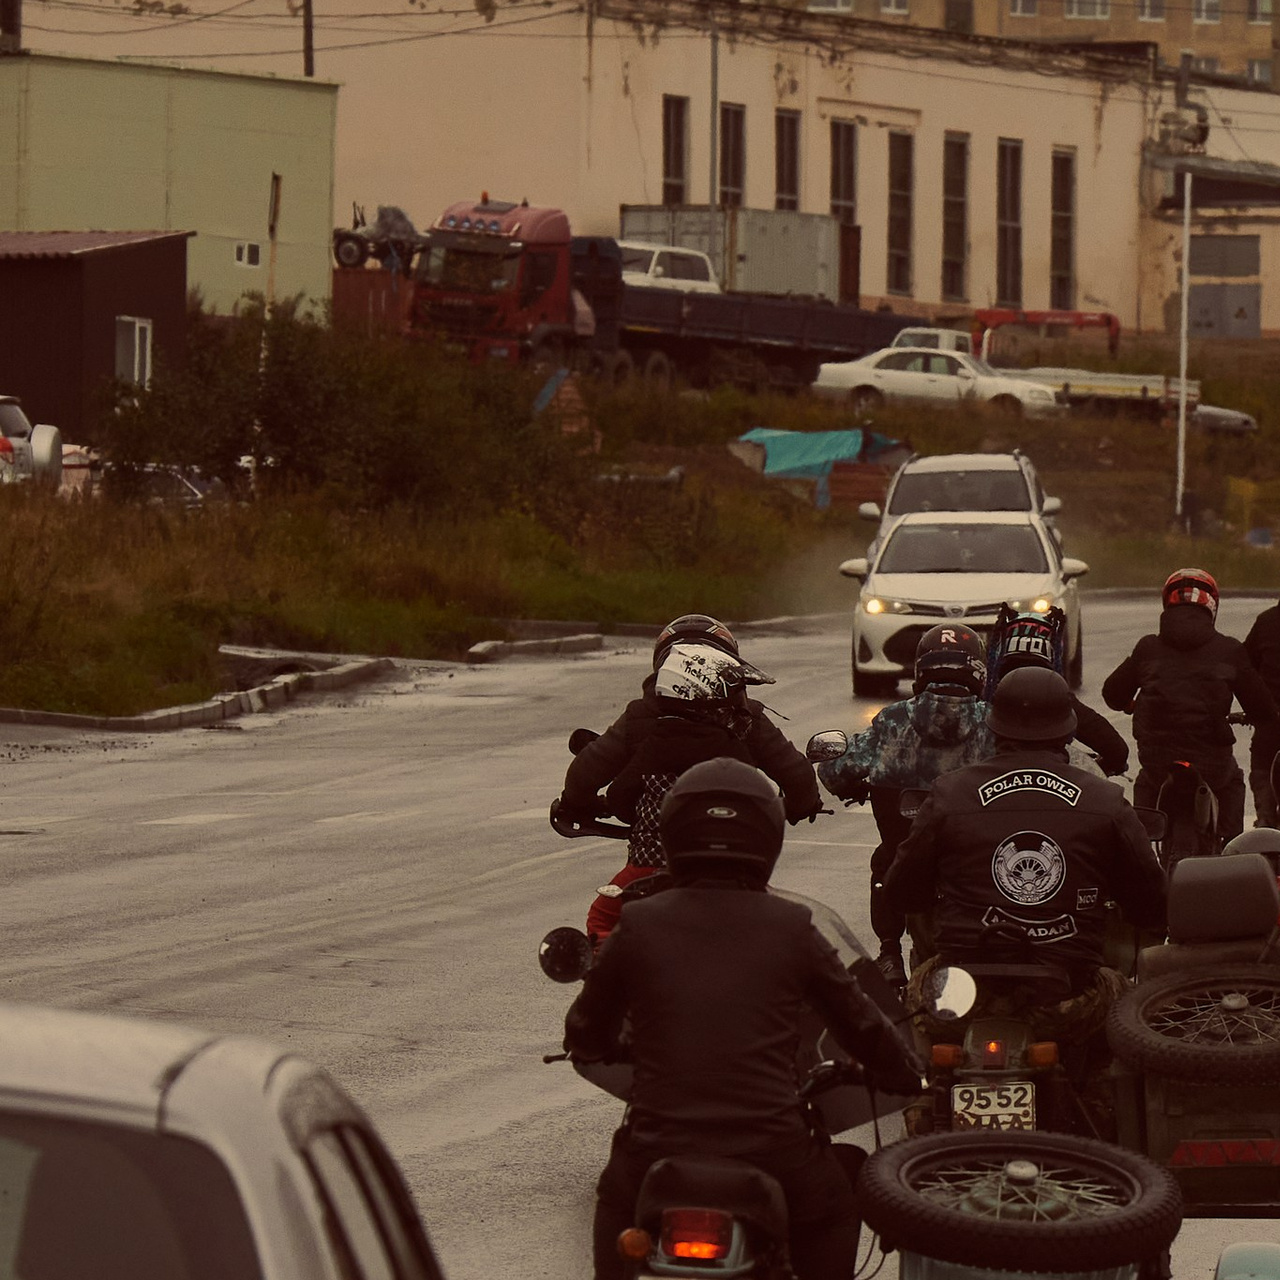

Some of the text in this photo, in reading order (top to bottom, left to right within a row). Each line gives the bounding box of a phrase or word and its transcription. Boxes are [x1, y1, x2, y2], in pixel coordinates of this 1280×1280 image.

[984, 774, 1076, 799] POLAR OWLS
[959, 1087, 1028, 1110] 9552
